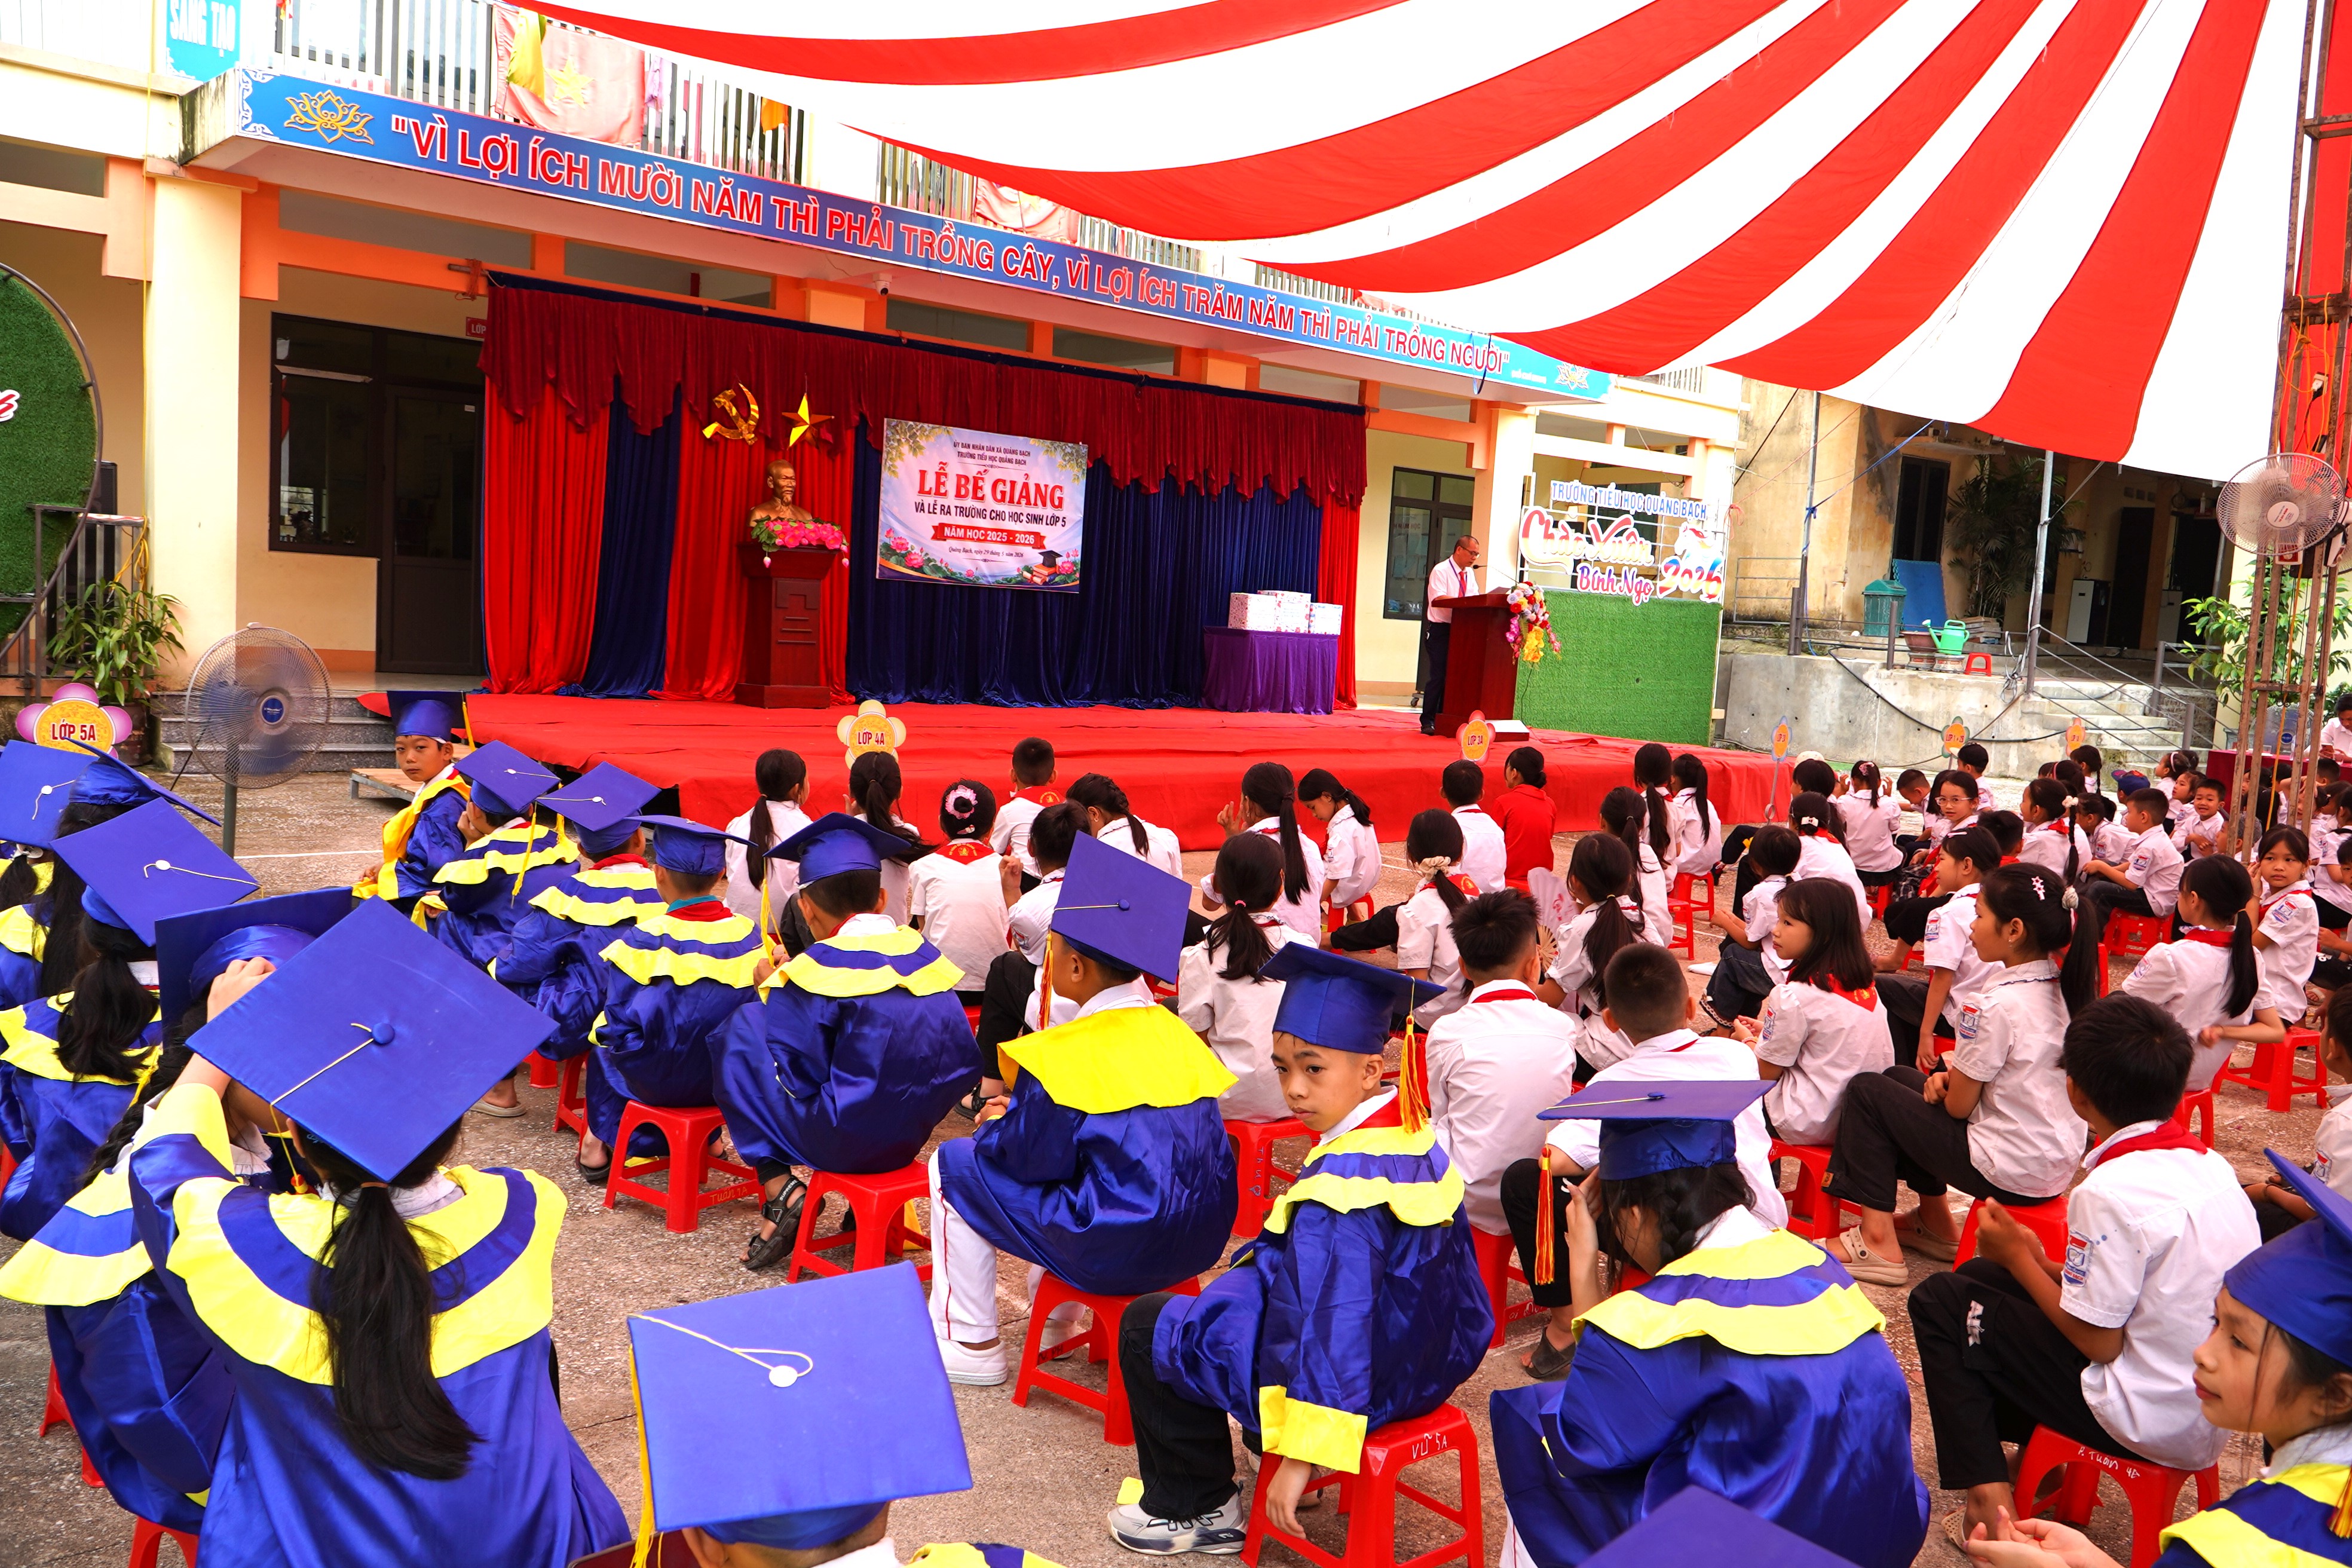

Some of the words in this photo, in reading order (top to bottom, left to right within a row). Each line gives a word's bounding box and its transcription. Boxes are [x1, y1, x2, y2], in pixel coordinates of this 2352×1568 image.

[211, 1, 235, 58] TẠO
[391, 113, 449, 163] "VÌ
[457, 128, 520, 180] LỢI
[528, 136, 590, 191] ÍCH
[599, 157, 683, 210] MƯỜI
[691, 176, 764, 225] NĂM
[770, 194, 819, 238] THÌ
[826, 205, 894, 252] PHẢI
[899, 219, 994, 271] TRỒNG
[1001, 242, 1060, 290] CÂY,
[1065, 253, 1091, 291] VÌ
[1094, 264, 1134, 304] LỢI
[1138, 268, 1177, 309] ÍCH
[1181, 284, 1244, 321] TRĂM
[1247, 294, 1295, 333] NĂM
[1299, 305, 1331, 339] THÌ
[1334, 314, 1381, 350] PHẢI
[1384, 323, 1446, 362] TRỒNG
[1449, 340, 1510, 375] NGƯỜI"
[471, 322, 487, 335] LỚP
[972, 443, 985, 451] NHÂN
[988, 455, 997, 463] HỌC
[917, 461, 949, 498] LỄ
[953, 469, 990, 503] BẾ
[990, 473, 1064, 510] GIẢNG
[914, 501, 926, 514] VÀ
[927, 499, 938, 516] LỄ
[939, 505, 952, 517] RA
[954, 503, 987, 520] TRƯỜNG
[989, 509, 1007, 522] CHO
[1008, 512, 1024, 526] HỌC
[1025, 513, 1044, 526] SINH
[1045, 512, 1060, 527] LỚP
[1061, 516, 1067, 528] 5
[1551, 481, 1595, 503] TRƯỜNG
[1596, 483, 1621, 508] TIỂU
[1623, 495, 1644, 513] HỌC
[1645, 492, 1680, 516] QUẢNG
[1681, 501, 1708, 521] BẠCH
[944, 524, 965, 538] NĂM
[966, 529, 985, 542] HỌC
[987, 531, 1008, 543] 2025
[1015, 533, 1035, 545] 2026
[1520, 509, 1586, 574] Chào
[1588, 516, 1653, 565] Xuân
[1578, 565, 1616, 592] Bính
[1618, 569, 1652, 604] Ngọ
[1658, 556, 1722, 599] 2026
[51, 719, 76, 740] LỚP
[79, 724, 96, 741] 5A
[858, 728, 872, 745] LỚP
[875, 732, 885, 745] 4A
[779, 1179, 798, 1201] SUPREME
[1435, 1432, 1447, 1451] 5A
